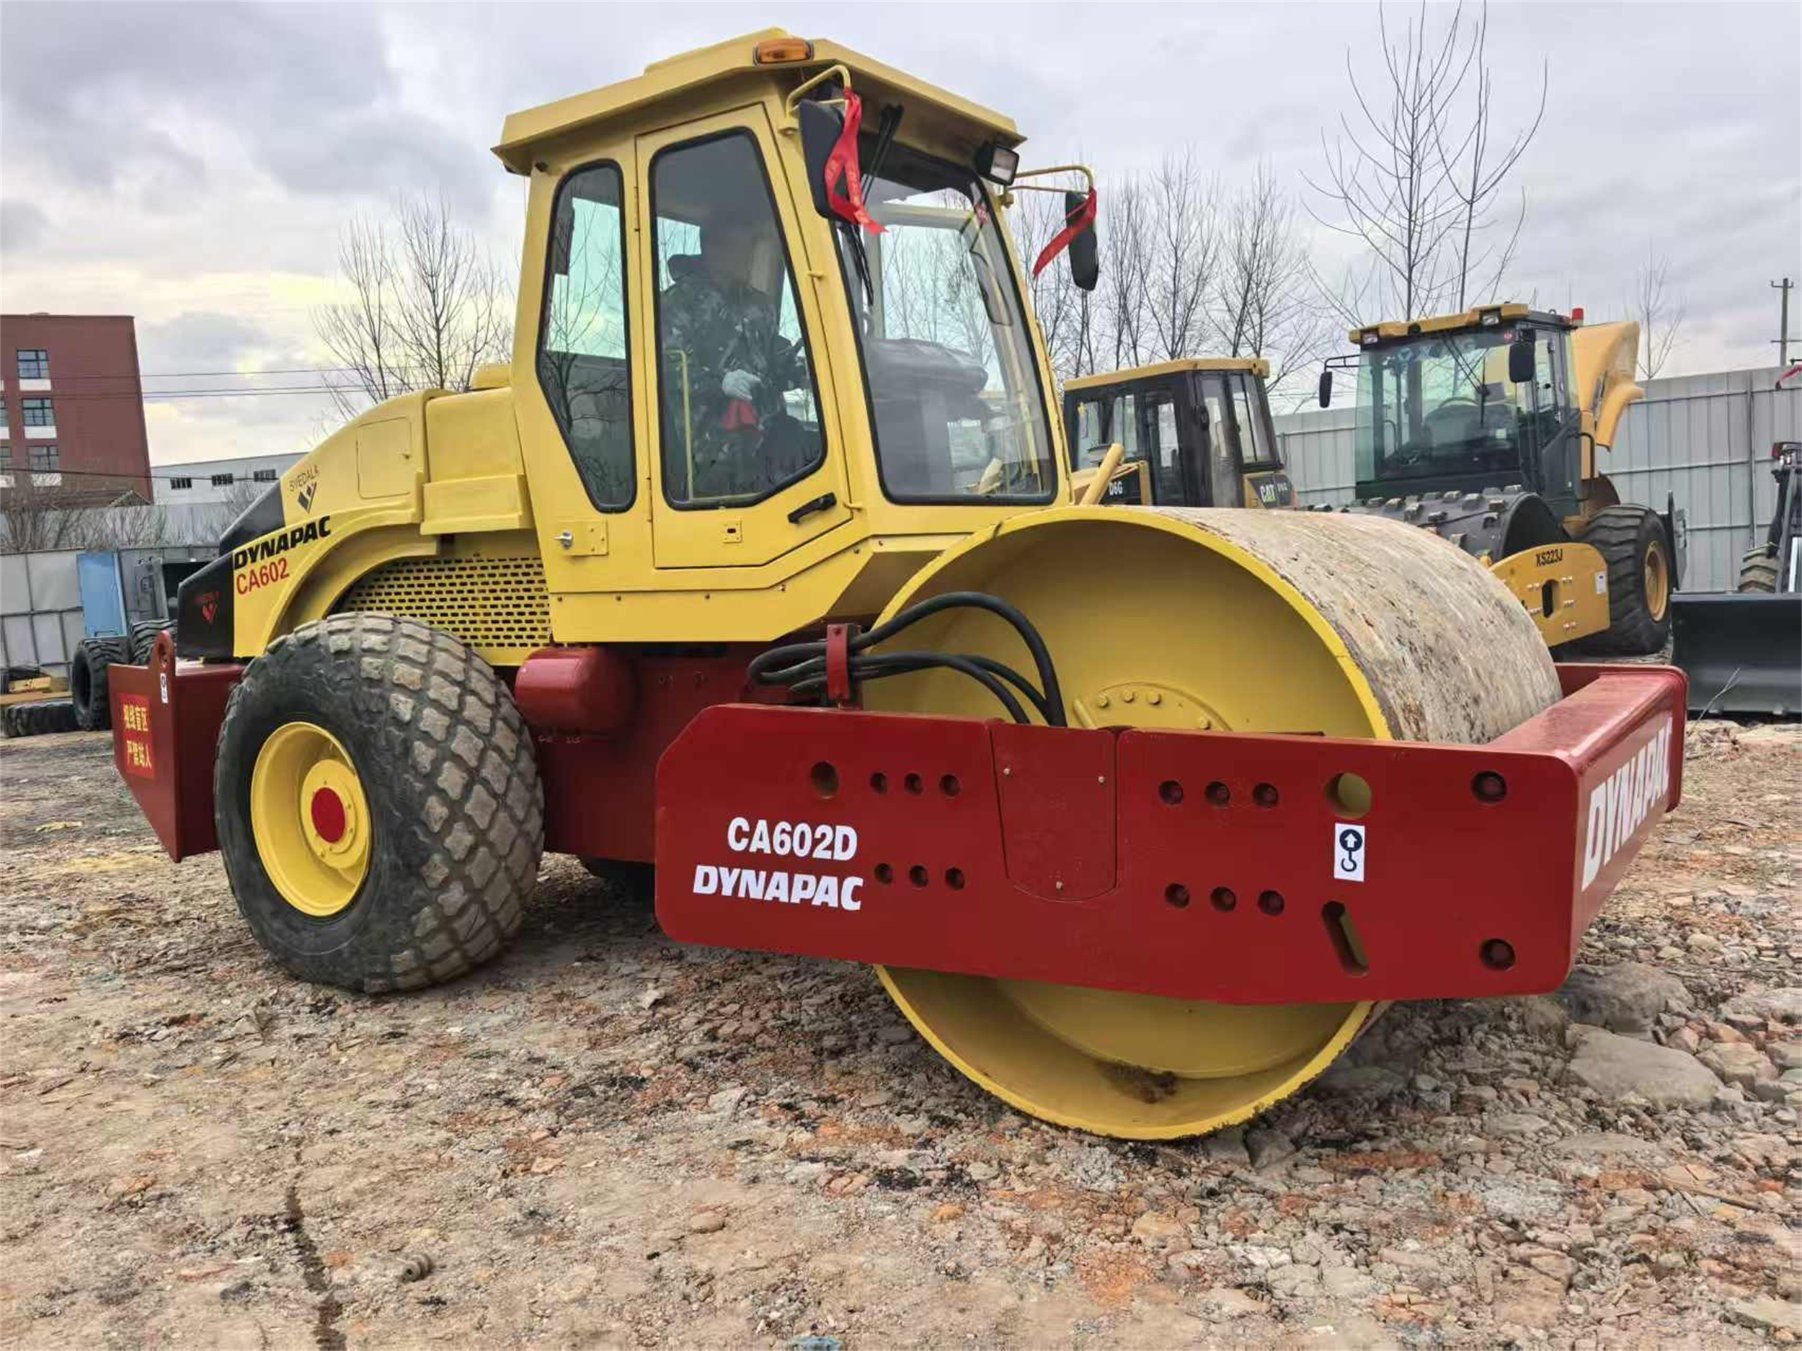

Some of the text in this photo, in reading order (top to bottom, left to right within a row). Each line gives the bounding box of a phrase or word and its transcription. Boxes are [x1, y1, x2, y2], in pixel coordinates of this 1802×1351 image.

[1259, 483, 1277, 503] CAT
[233, 515, 332, 570] DYNAPAC
[236, 557, 290, 596] CA602
[1581, 715, 1674, 893] DYNAPAC
[727, 816, 858, 861] CA602D
[692, 864, 864, 911] DYNAPAC
